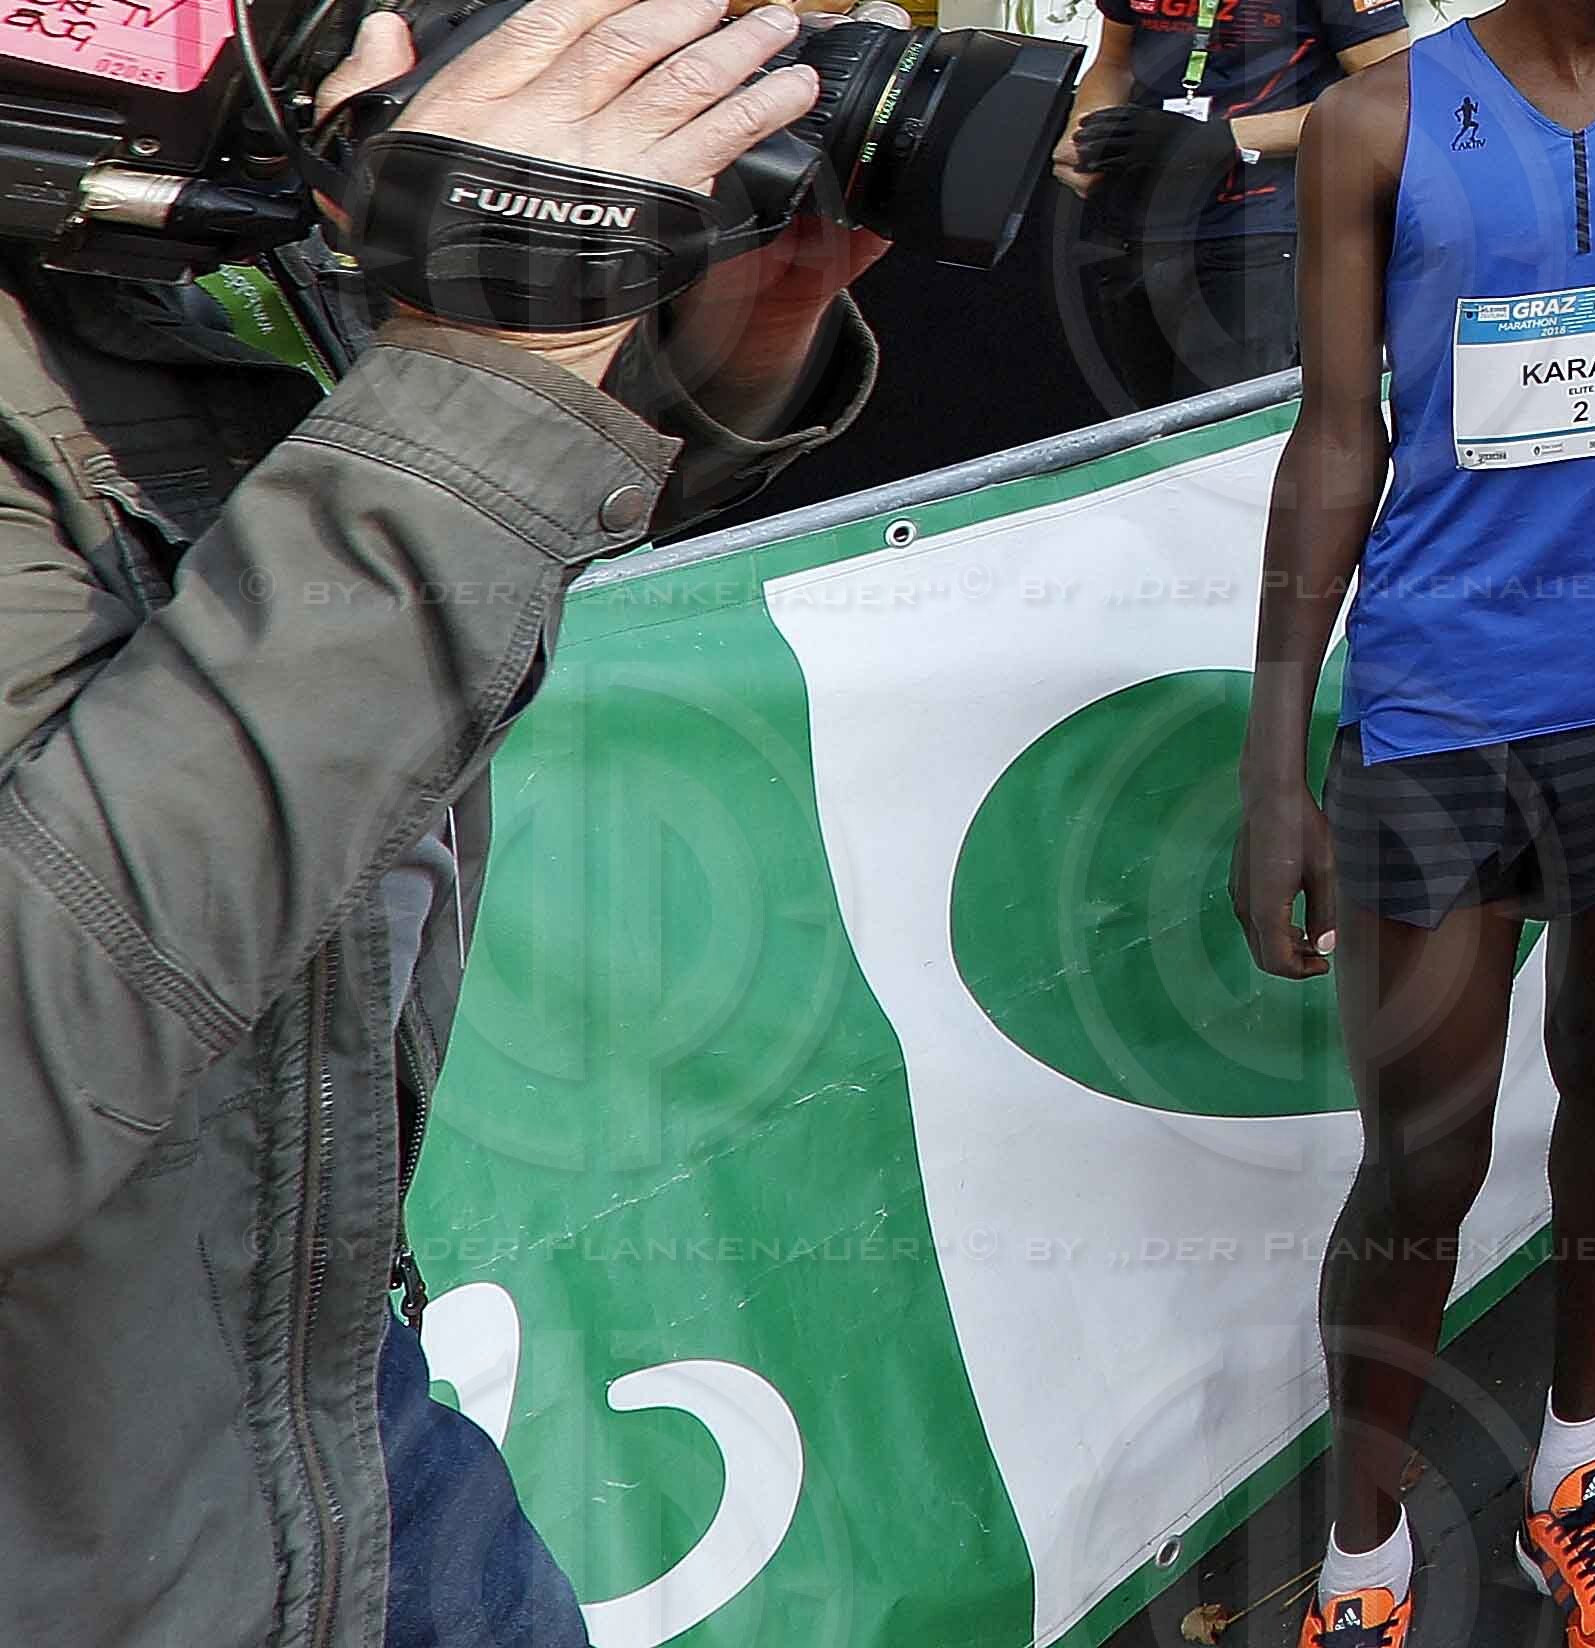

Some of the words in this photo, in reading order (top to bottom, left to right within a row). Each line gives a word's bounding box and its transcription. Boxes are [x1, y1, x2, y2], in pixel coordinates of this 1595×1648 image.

[1513, 295, 1577, 319] GRAZ
[1498, 317, 1557, 331] MARATHON
[1541, 326, 1567, 337] 2018
[1569, 386, 1594, 396] ELITE
[1573, 401, 1589, 423] 2
